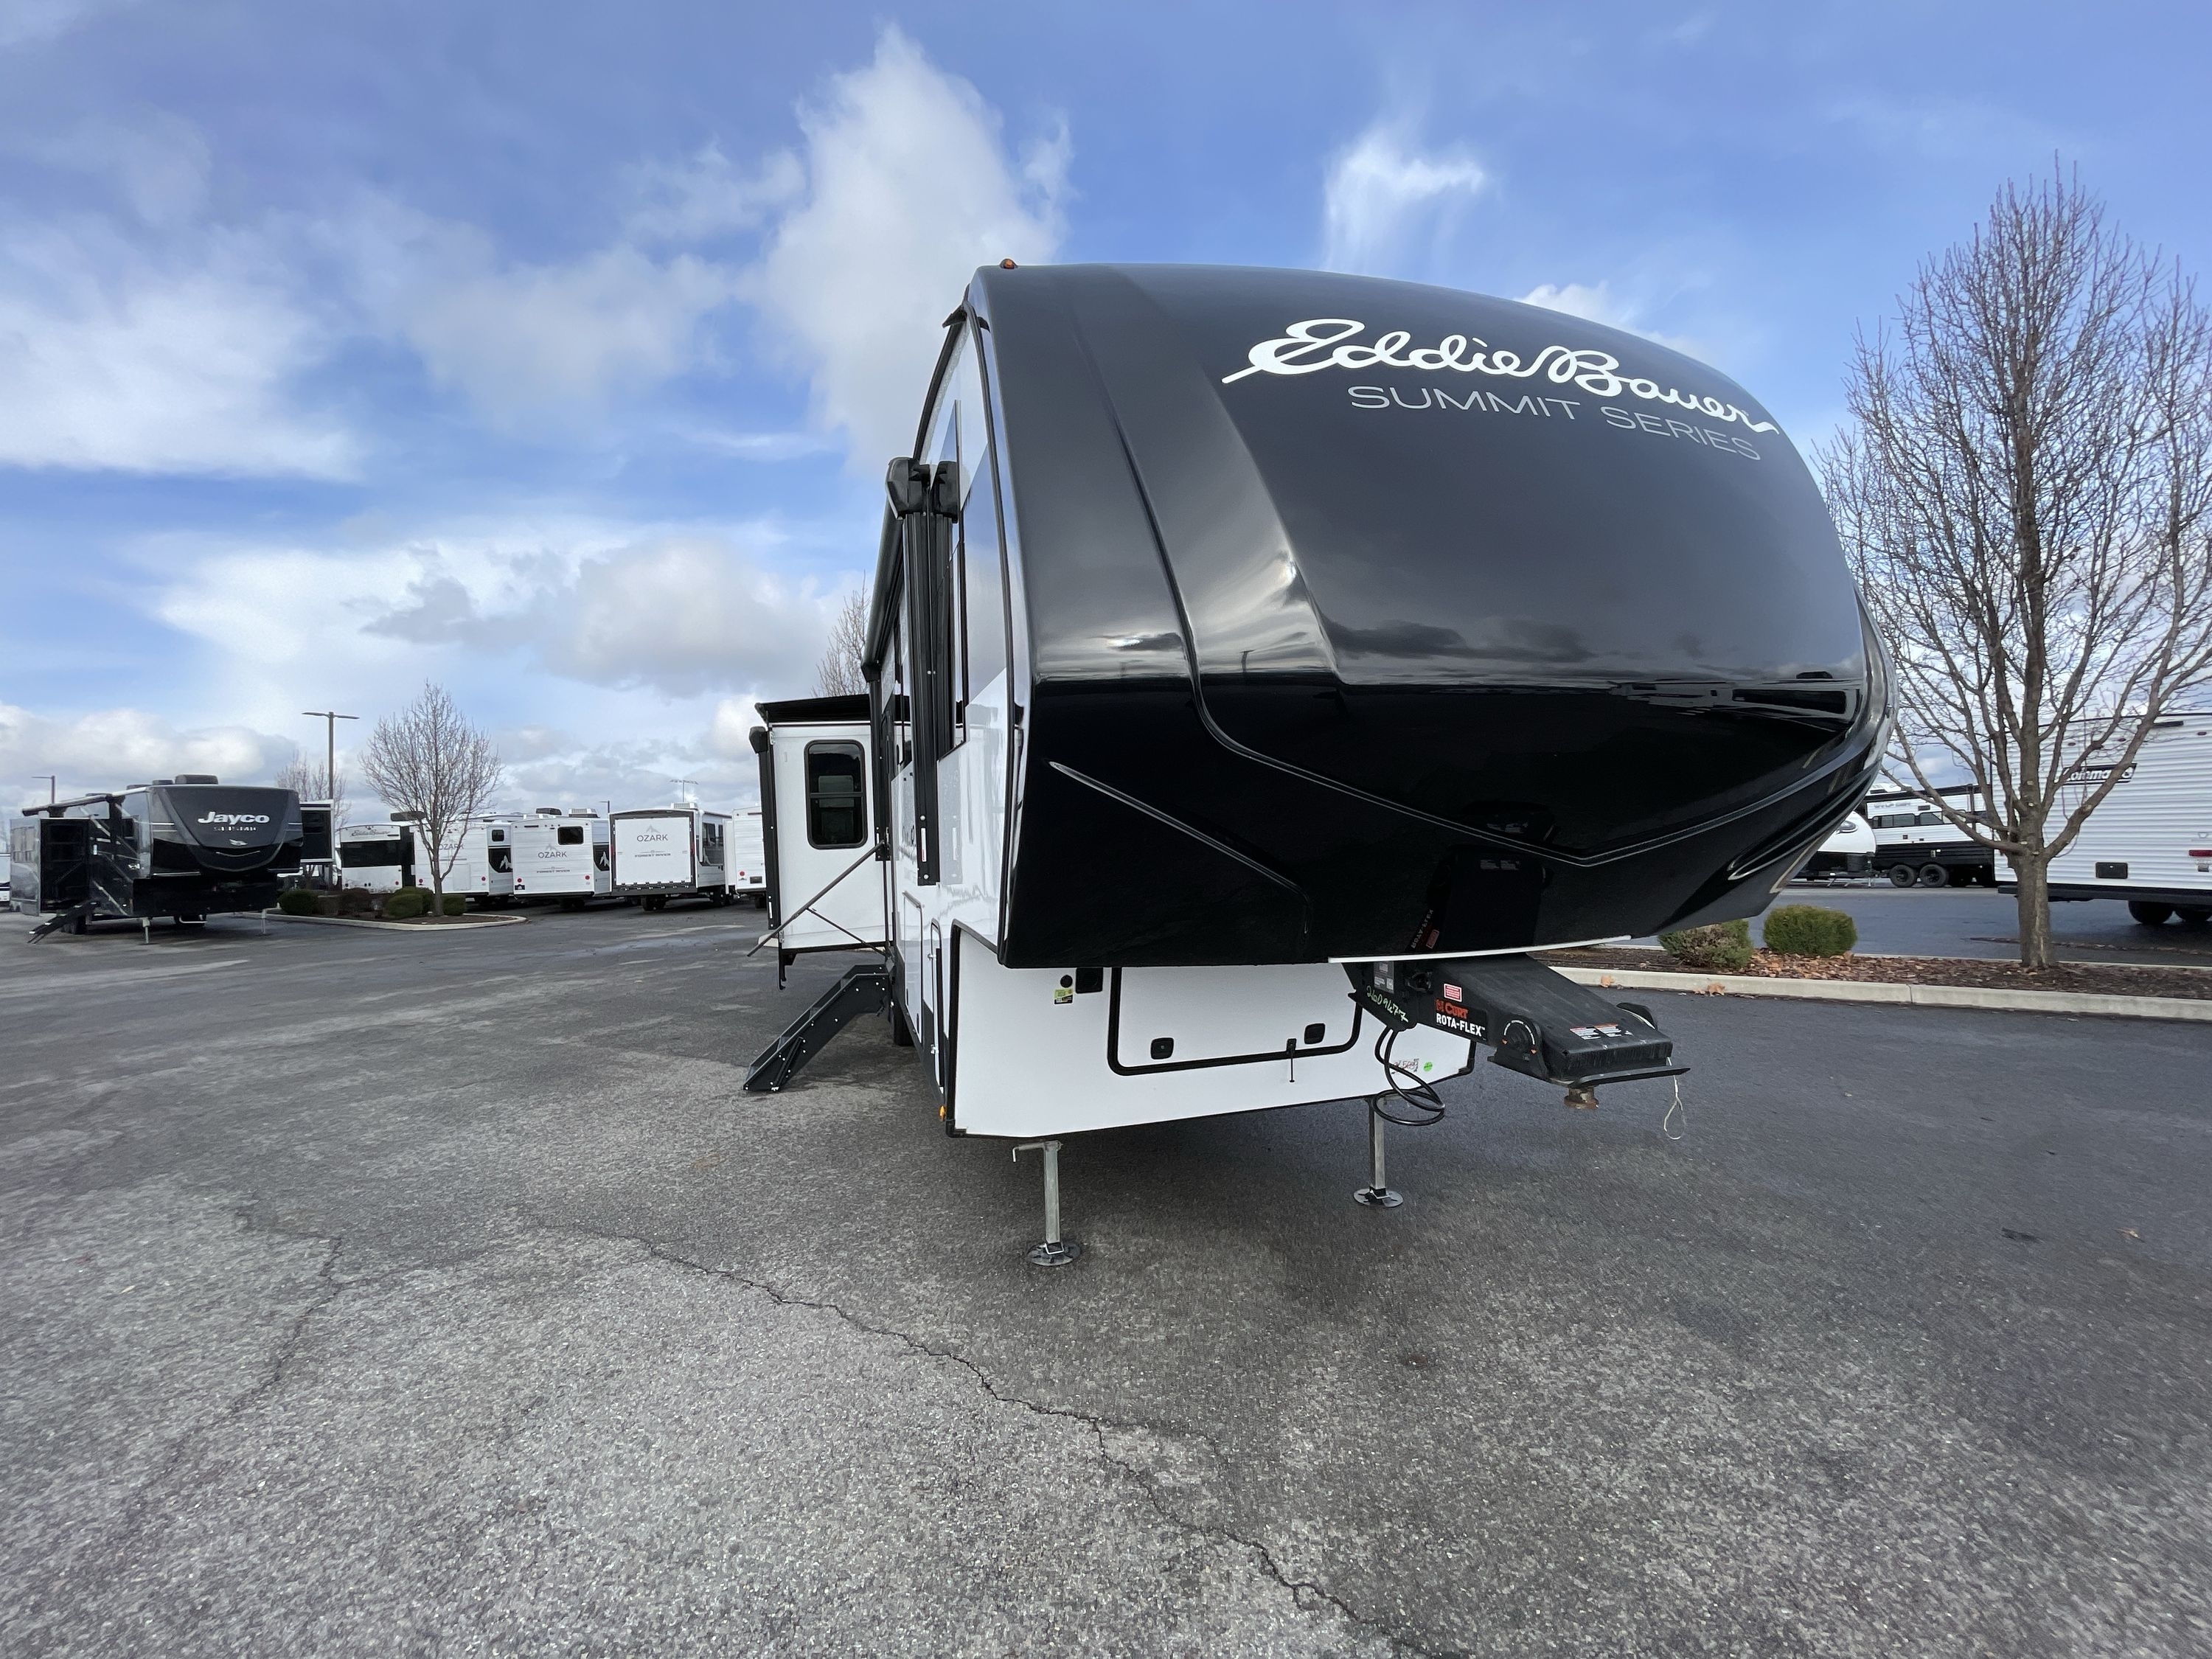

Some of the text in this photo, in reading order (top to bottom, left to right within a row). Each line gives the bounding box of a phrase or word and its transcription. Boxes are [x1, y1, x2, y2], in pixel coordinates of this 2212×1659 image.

[1221, 319, 1780, 435] Eddie Bauer
[1348, 386, 1761, 460] SUMMIT SERIES
[2062, 767, 2121, 782] olema
[198, 811, 270, 825] Jayco
[637, 834, 669, 842] OZARK
[538, 851, 567, 859] OZARK
[1436, 1013, 1483, 1037] ROTA-FLEX
